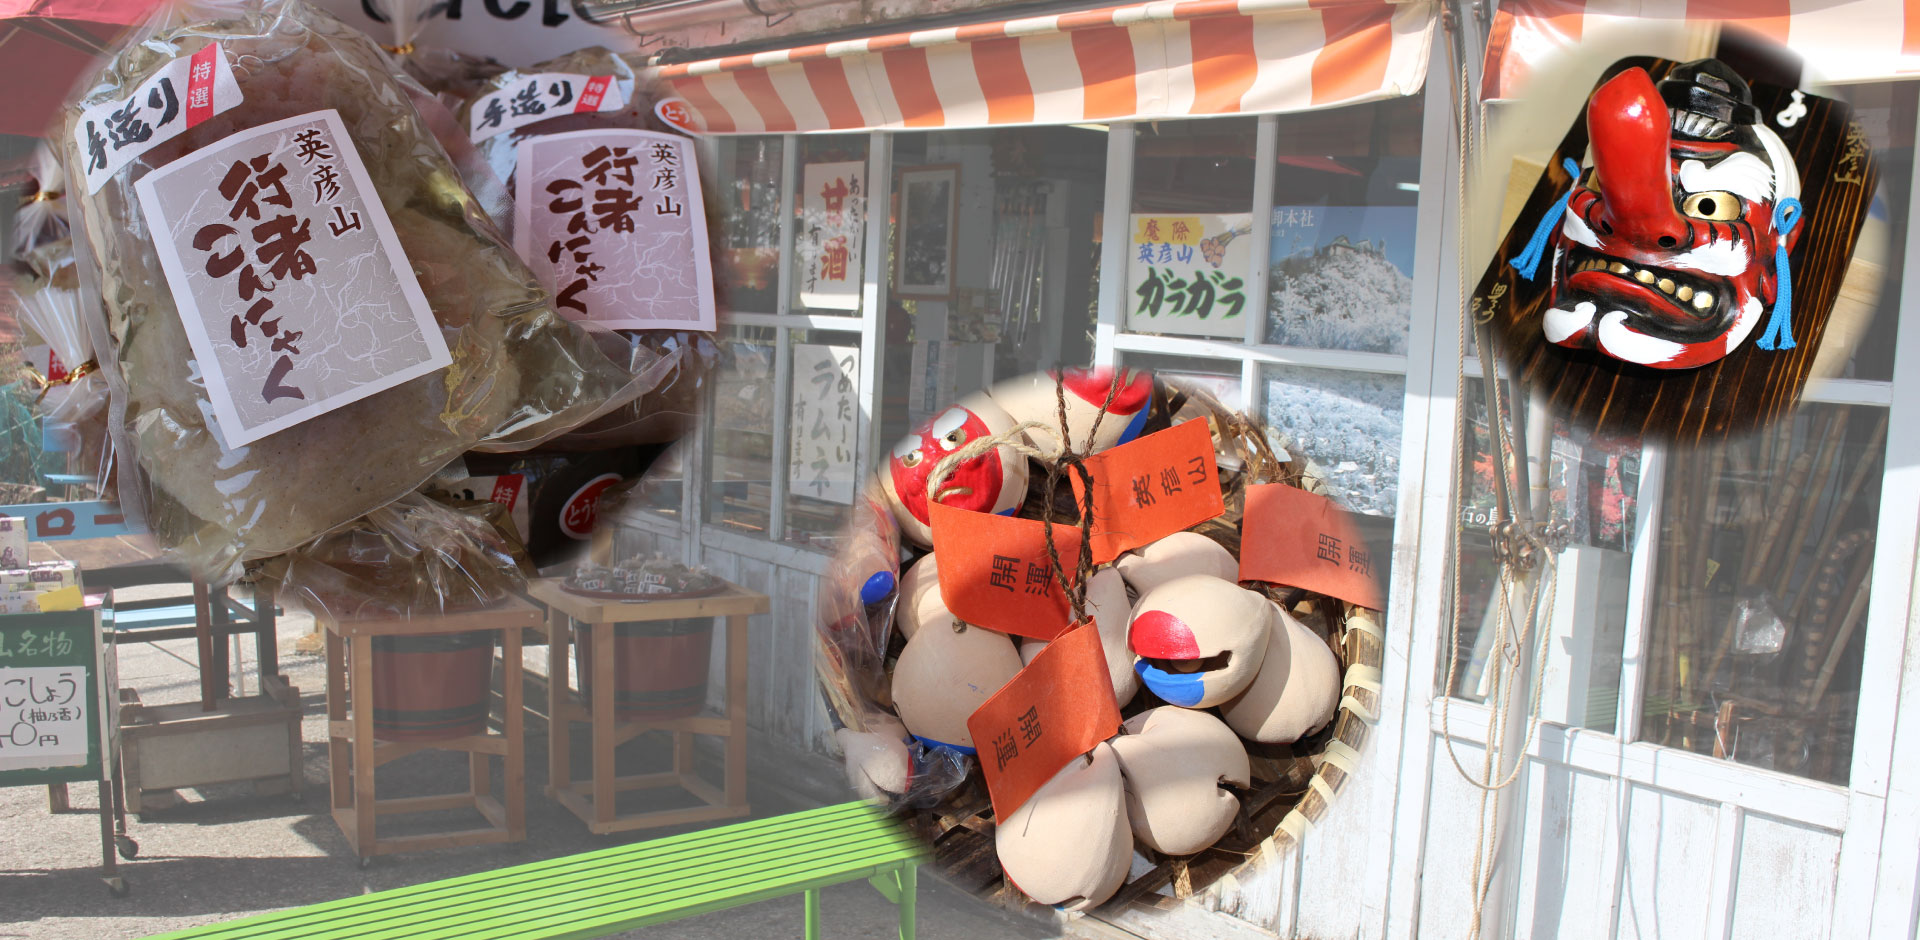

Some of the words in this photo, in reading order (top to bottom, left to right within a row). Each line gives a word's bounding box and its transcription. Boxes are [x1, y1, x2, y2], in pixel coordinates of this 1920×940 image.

[190, 61, 212, 109] 特選
[476, 79, 574, 131] 手造り
[580, 81, 605, 108] 特選
[86, 77, 180, 176] 手造り
[293, 129, 361, 238] 英彦山
[582, 145, 644, 234] 行者
[651, 143, 682, 217] 英彦山
[218, 152, 318, 281] 行者
[545, 178, 606, 316] こんにゃく
[820, 176, 849, 282] 甘酒
[1143, 218, 1191, 242] 魔除
[1136, 241, 1194, 265] 英彦山
[192, 223, 306, 405] こんにゃく
[1134, 266, 1247, 321] ガラガラ
[808, 358, 835, 497] ラムネ
[836, 354, 855, 463] つめたーい
[1131, 455, 1208, 509] 英彦山
[989, 553, 1053, 599] 開運
[0, 672, 77, 709] こしょう
[0, 721, 59, 748] 0円
[991, 704, 1043, 773] 開運
